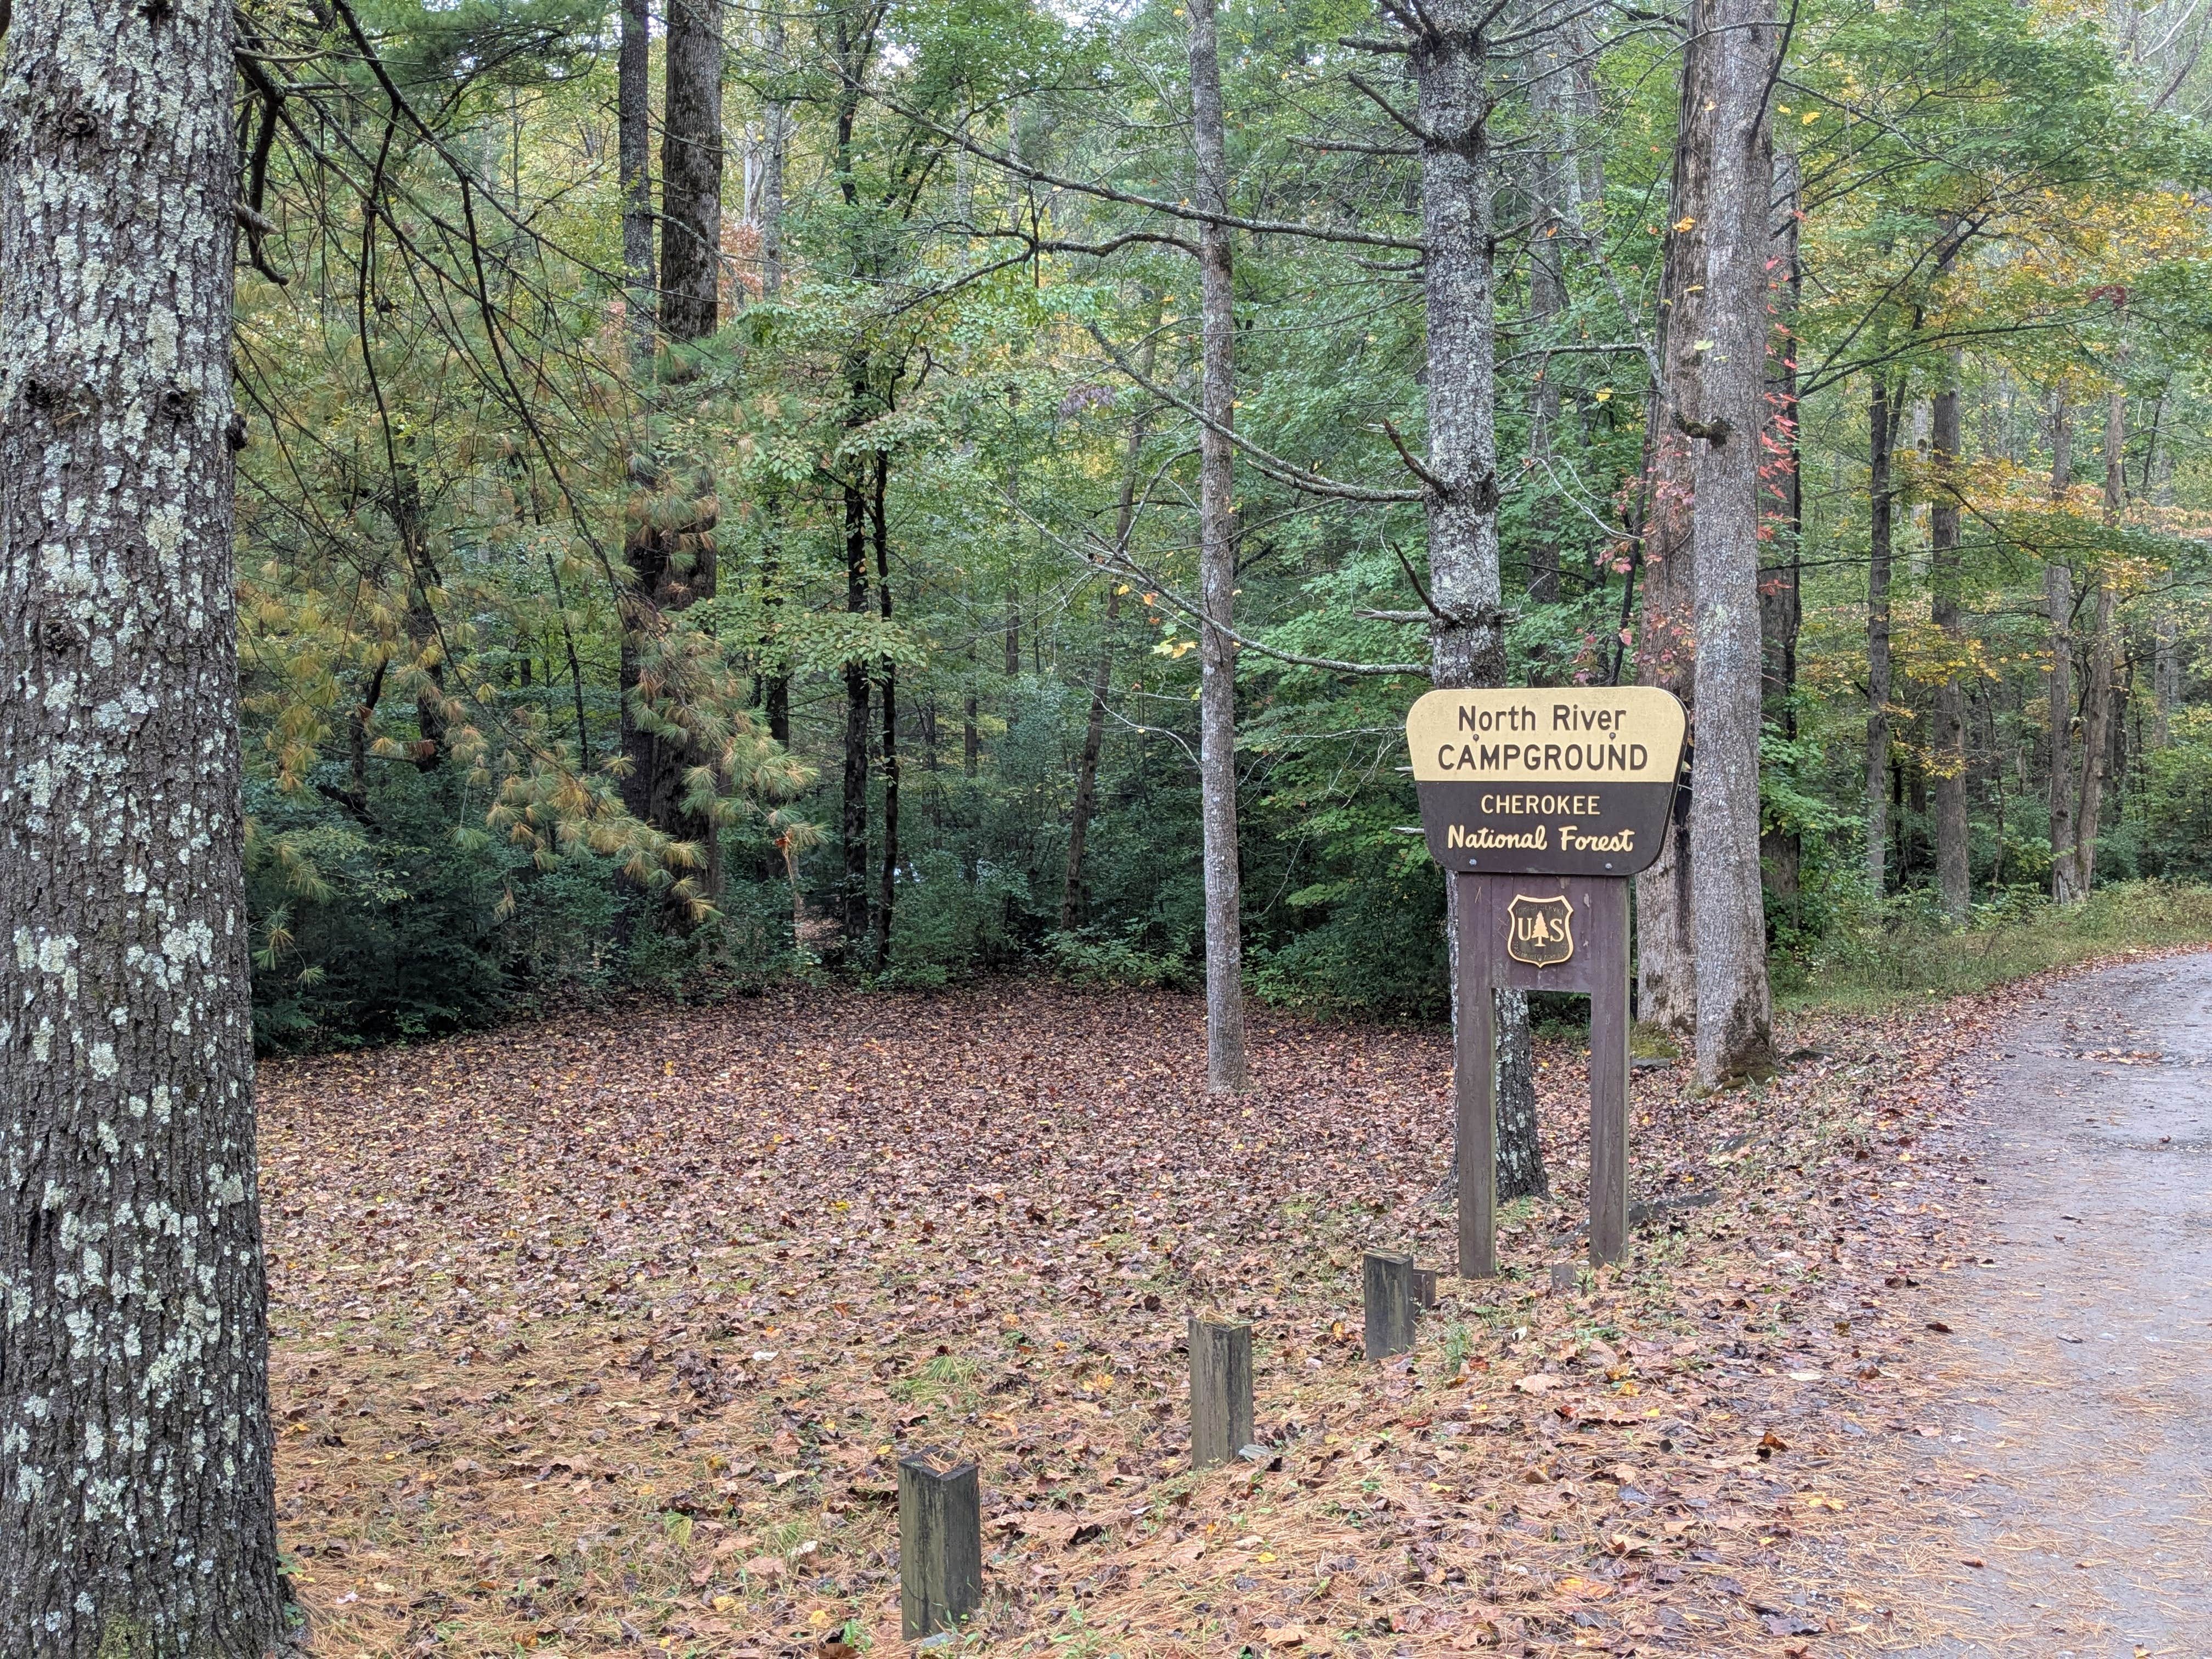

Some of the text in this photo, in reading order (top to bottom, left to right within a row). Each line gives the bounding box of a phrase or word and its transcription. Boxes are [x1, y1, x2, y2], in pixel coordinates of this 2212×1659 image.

[1458, 704, 1627, 732] North River
[1437, 743, 1648, 771] CAMPGROUND
[1481, 794, 1601, 815] CHEROKEE
[1447, 825, 1635, 852] National Forest
